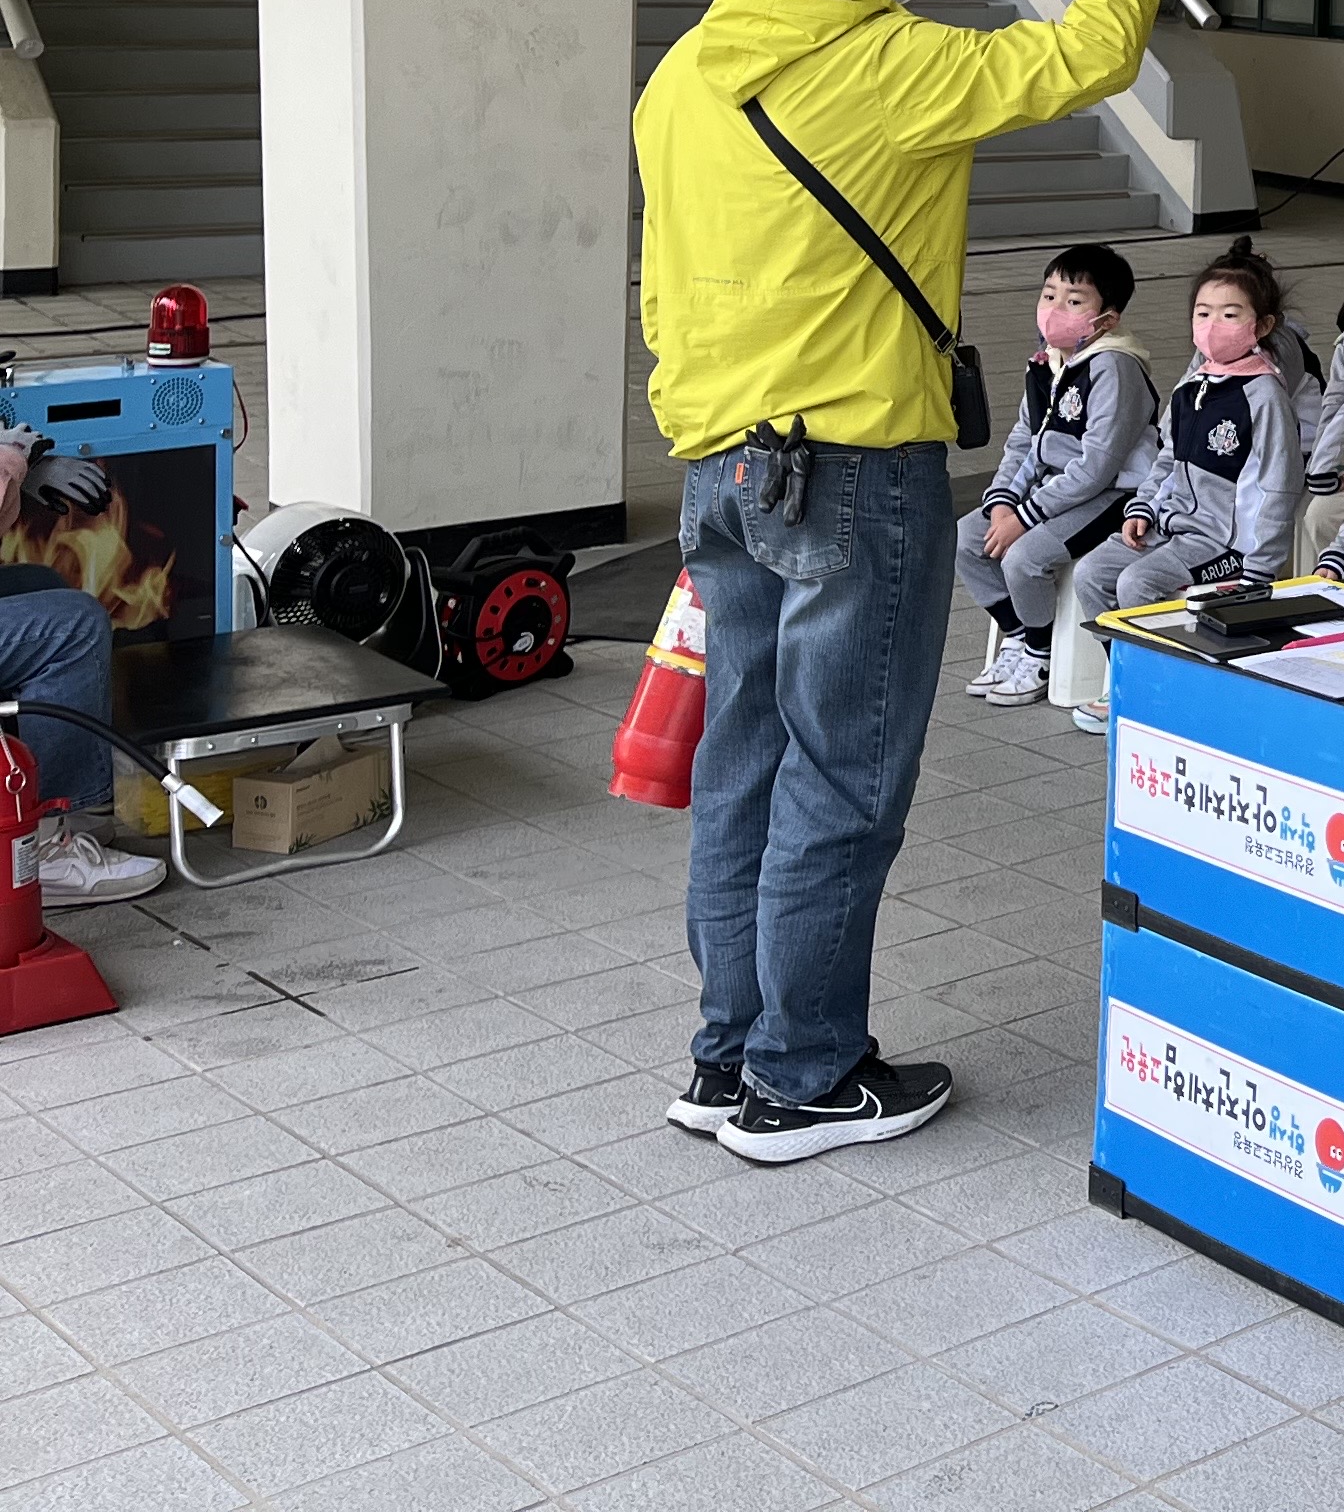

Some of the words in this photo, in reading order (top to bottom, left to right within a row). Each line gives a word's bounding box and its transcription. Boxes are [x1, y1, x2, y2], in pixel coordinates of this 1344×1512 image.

[1201, 555, 1243, 584] ARUBA
[1244, 835, 1315, 877] 경상남도교육청
[1232, 1131, 1304, 1180] 경상남도교육청
